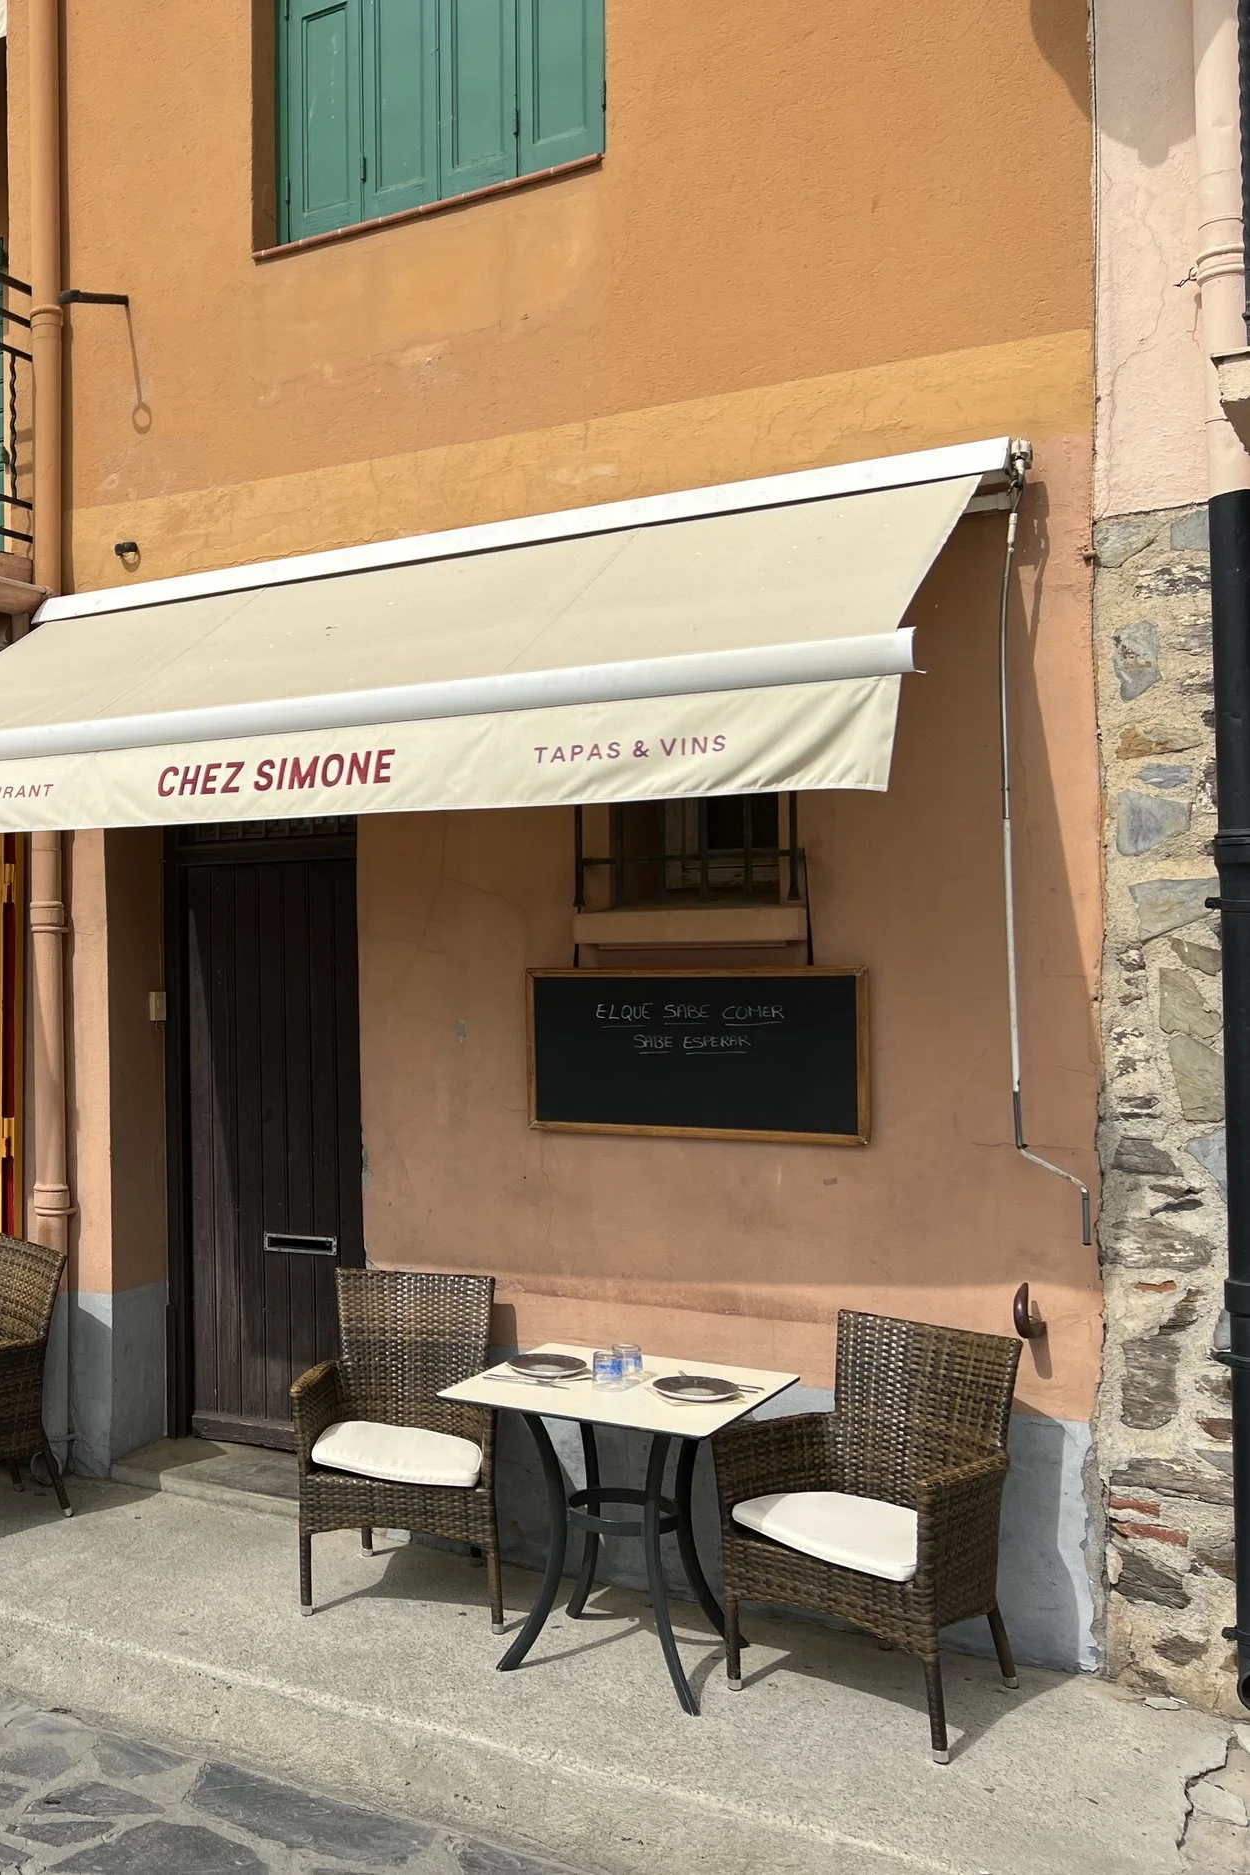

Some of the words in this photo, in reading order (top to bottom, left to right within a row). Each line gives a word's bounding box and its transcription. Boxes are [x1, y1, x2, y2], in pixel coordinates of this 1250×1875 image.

[534, 742, 621, 763] TAPAS
[633, 740, 649, 758] &
[660, 735, 726, 756] VINS
[158, 761, 245, 797] CHEZ
[254, 749, 396, 792] SIMONE
[663, 1004, 710, 1019] SABE
[722, 1005, 784, 1020] COMER
[633, 1034, 673, 1048] SABE
[683, 1035, 751, 1049] ESPERAR
